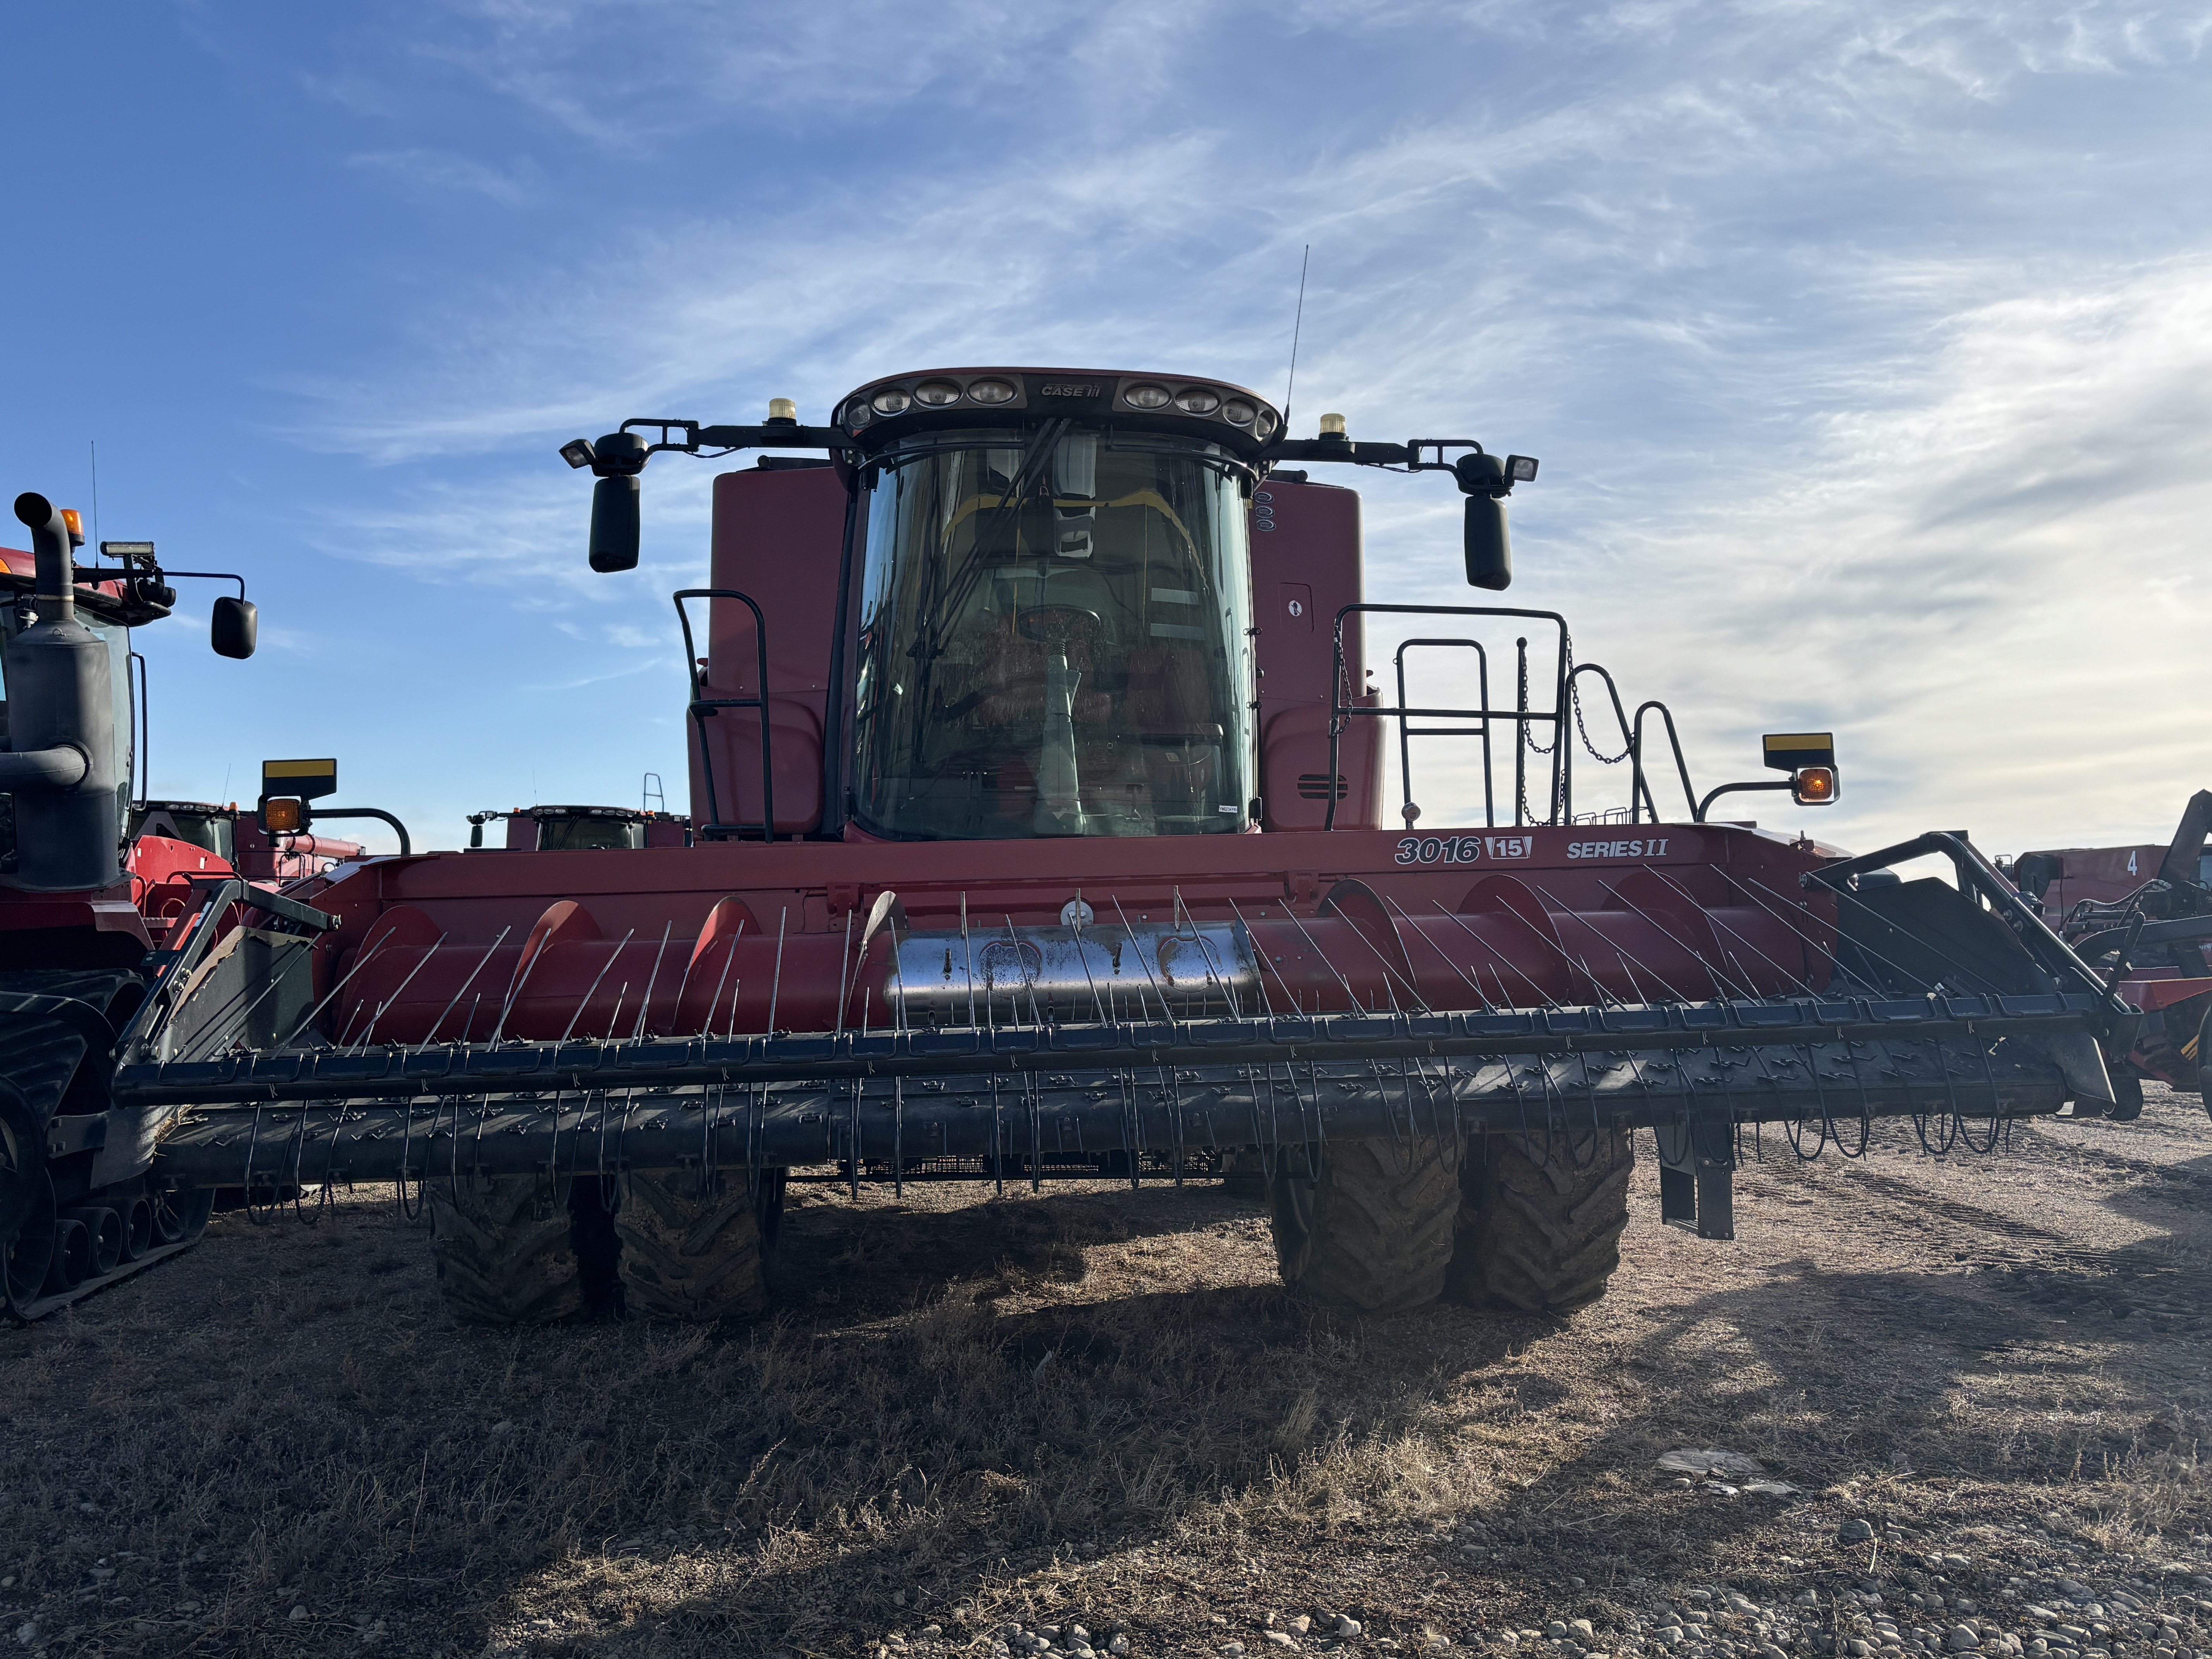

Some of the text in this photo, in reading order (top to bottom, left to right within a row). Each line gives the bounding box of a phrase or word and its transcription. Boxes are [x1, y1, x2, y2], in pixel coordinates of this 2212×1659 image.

[1041, 386, 1084, 397] CASE
[1395, 836, 1669, 865] 3016 15 SERIES II
[2127, 850, 2137, 876] 4
